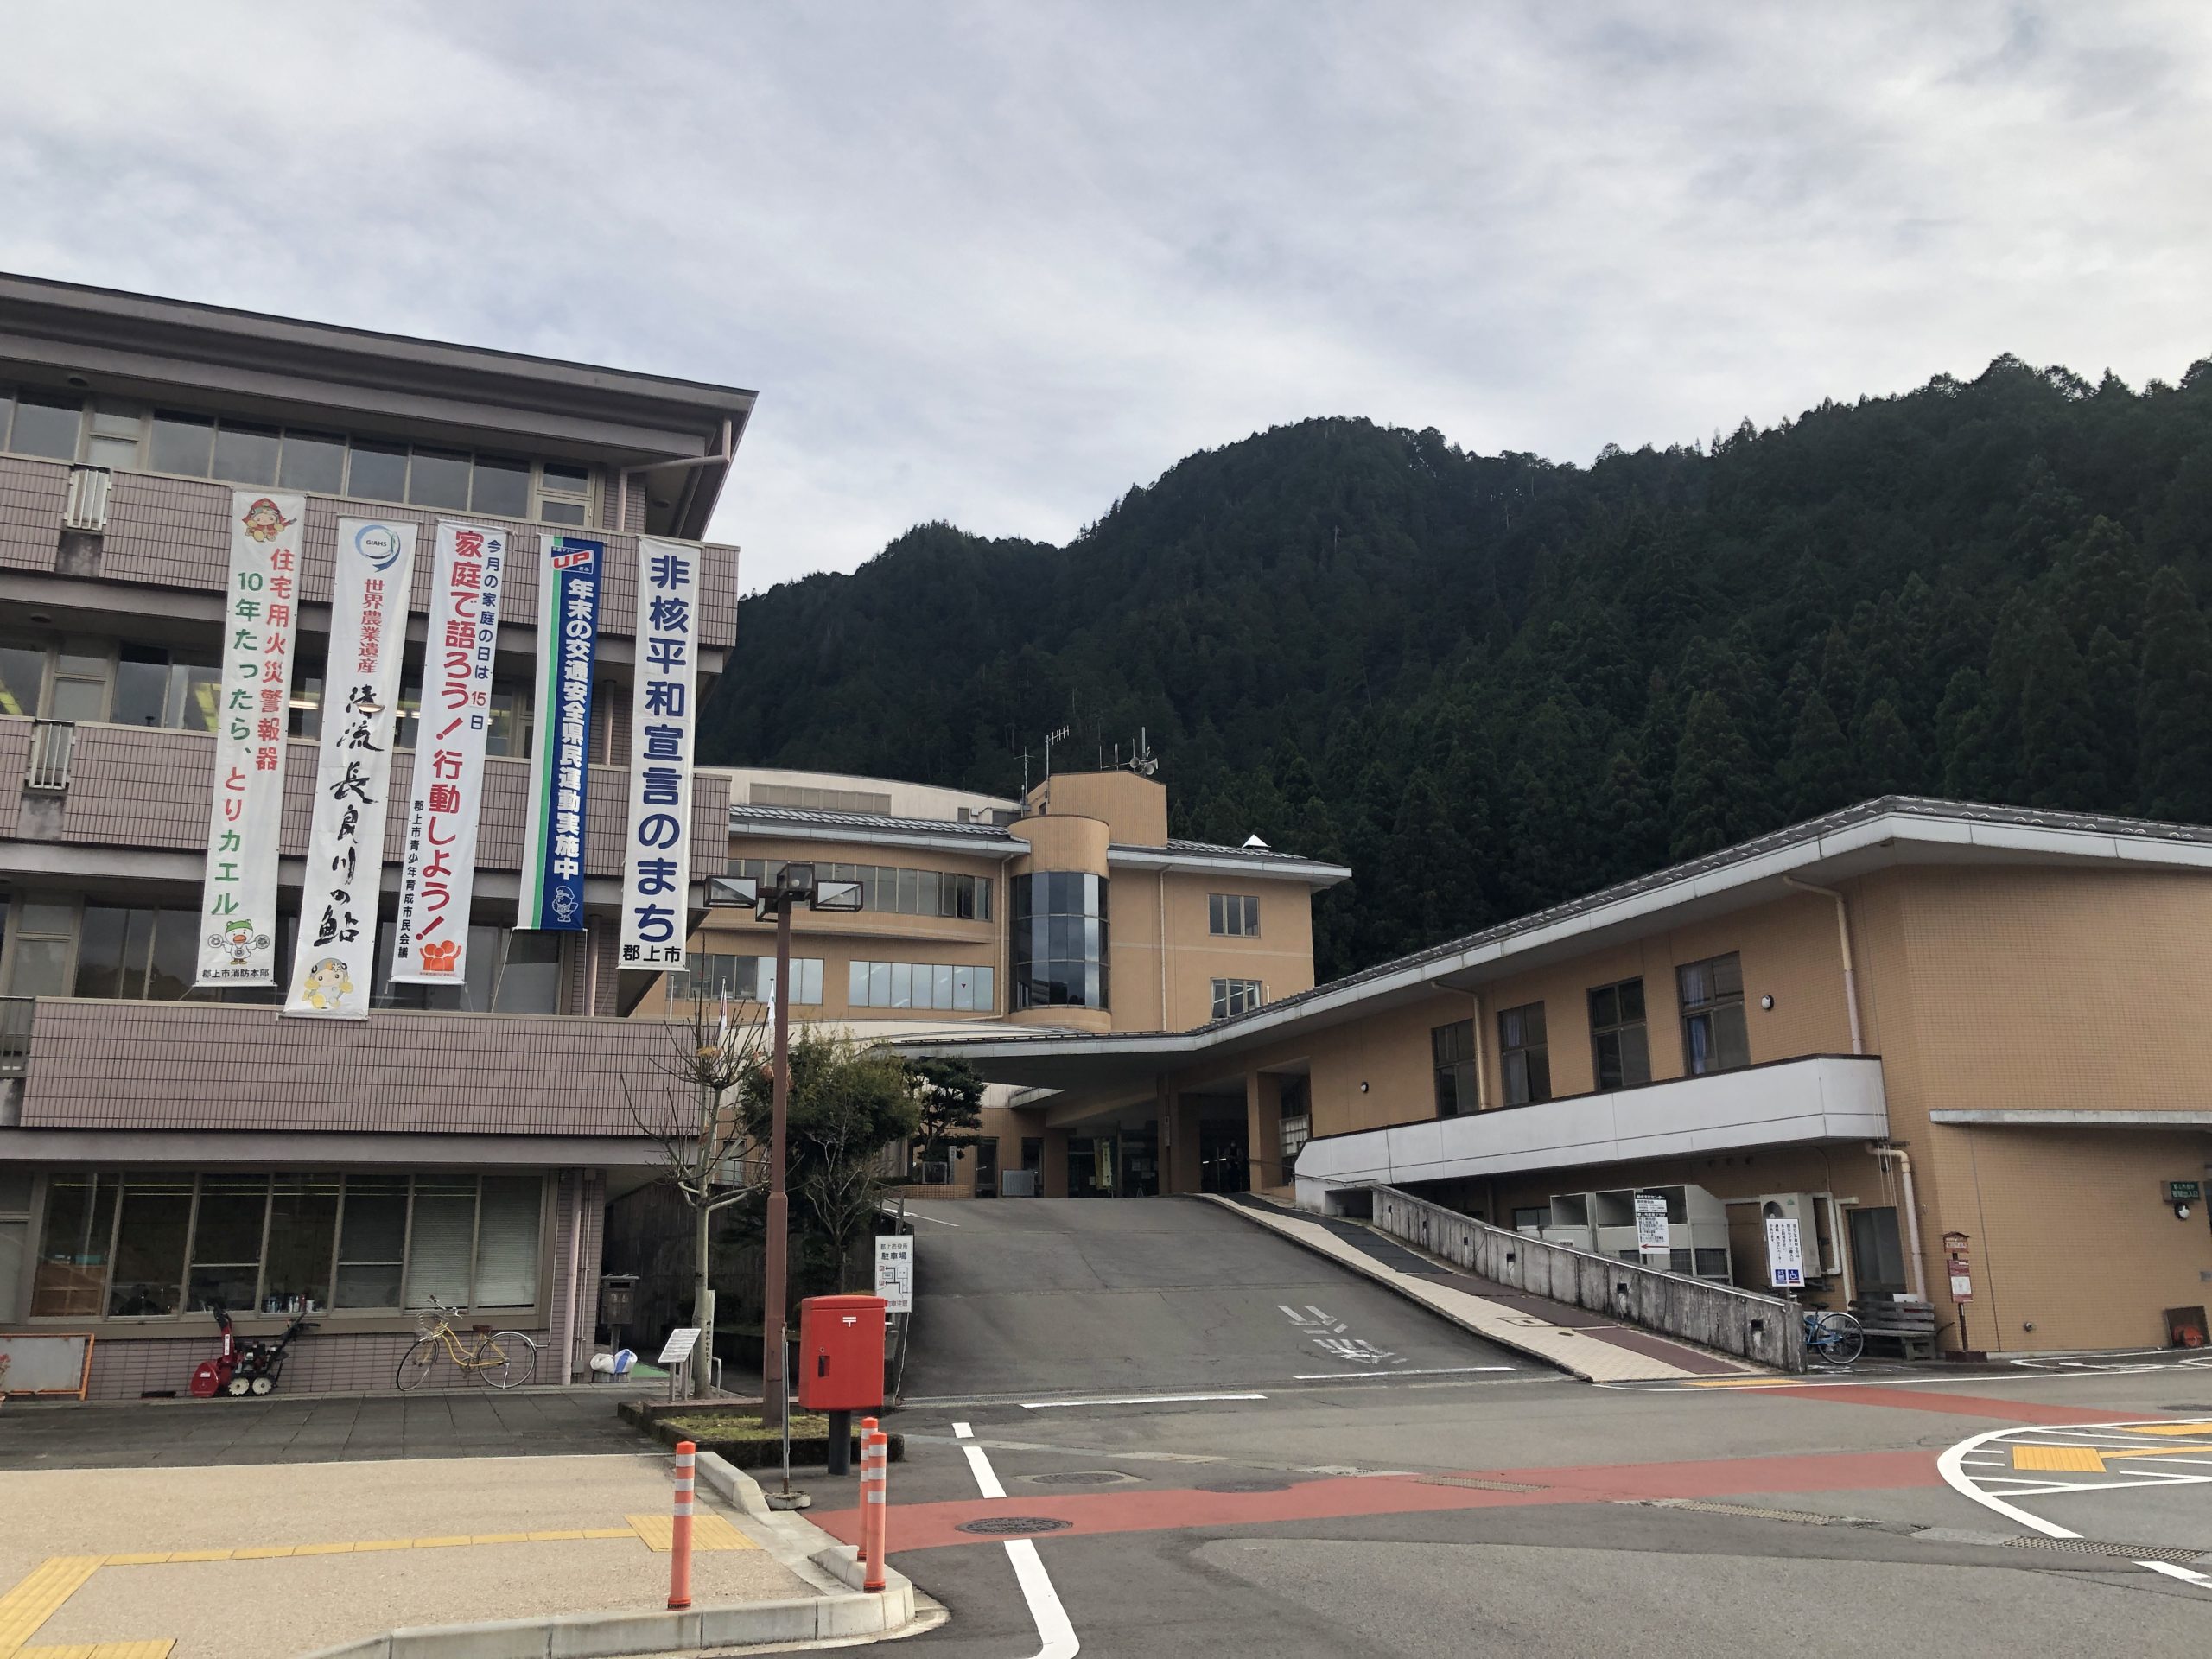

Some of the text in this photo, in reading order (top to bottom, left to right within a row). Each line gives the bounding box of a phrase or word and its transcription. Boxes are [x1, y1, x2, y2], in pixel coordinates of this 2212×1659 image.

[554, 552, 589, 569] UP
[256, 548, 295, 771] 住宅用火災警報器
[356, 579, 385, 673] 世界農業遺産
[553, 578, 594, 880] 年末の交通安全県民運動実施中
[634, 555, 690, 942] 非核平和宣言のまち
[397, 800, 424, 958] 郡上市青少年育成市民会議
[201, 969, 270, 978] 郡上市消防本部
[622, 944, 682, 963] 郡上市
[881, 1251, 907, 1260] 駐車場
